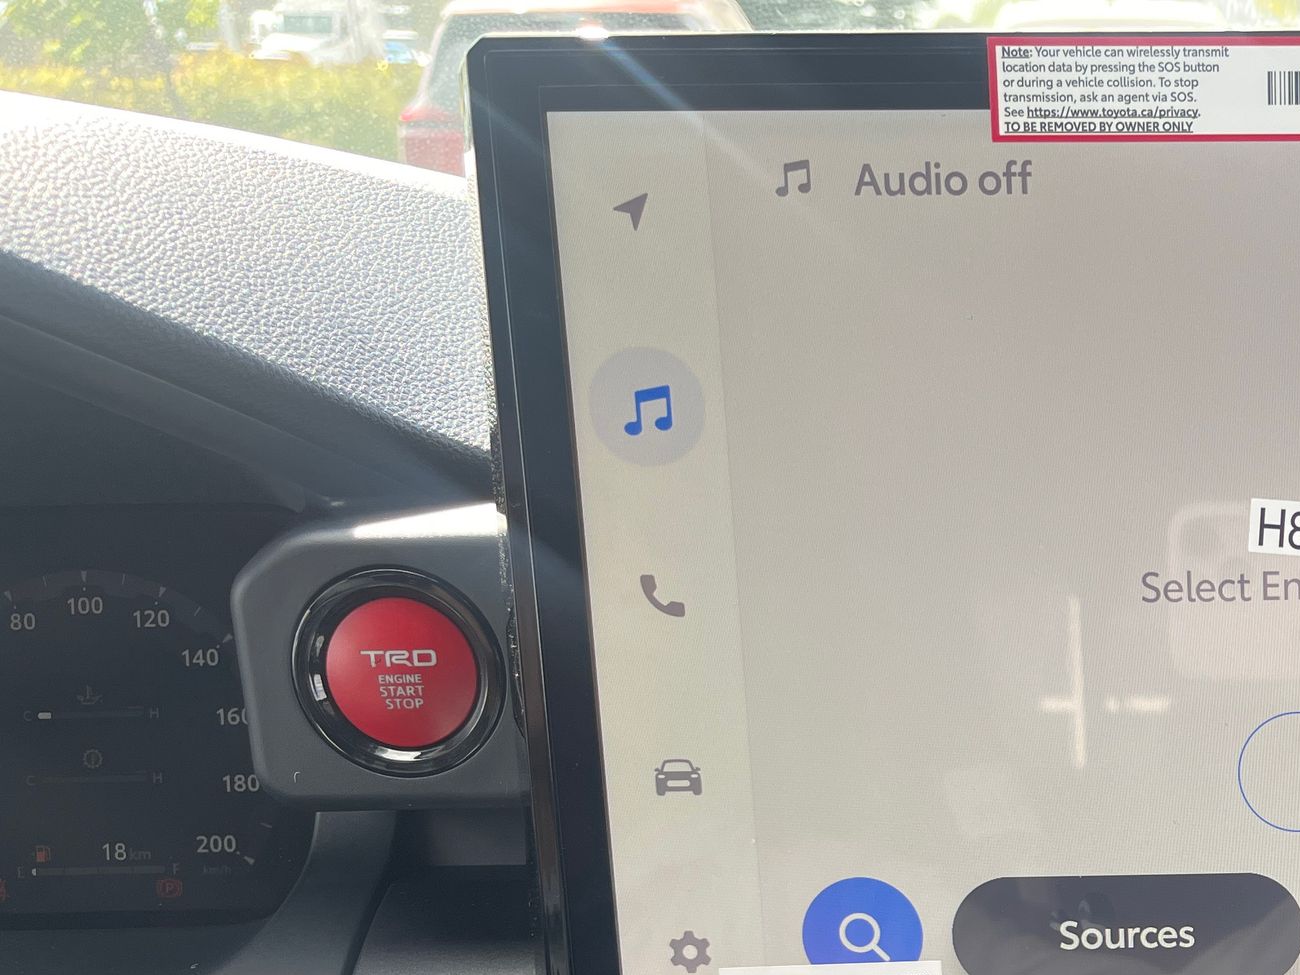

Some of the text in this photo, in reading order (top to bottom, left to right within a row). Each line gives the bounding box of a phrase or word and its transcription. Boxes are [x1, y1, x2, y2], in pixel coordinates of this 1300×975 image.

[1001, 46, 1230, 59] Note: Your vehicle can wirelessly transmit
[1002, 61, 1220, 75] location data by pressing the SOS button
[1003, 77, 1199, 90] or during a vehicle collision. To stop
[1003, 92, 1197, 105] transmission, ask an agent via SOS.
[1004, 106, 1201, 119] See https://www.toyota.ca/privacy.
[1004, 121, 1194, 133] TO BE REMOVED BY OWNER ONLY
[855, 160, 1033, 196] Audio off
[1140, 571, 1251, 603] Select
[67, 597, 103, 615] 100
[10, 612, 36, 630] 80
[133, 610, 170, 628] 120
[181, 648, 219, 666] 140
[360, 649, 437, 668] TRD
[378, 674, 422, 684] ENGINE
[380, 685, 424, 697] START
[386, 698, 424, 709] STOP
[222, 774, 260, 792] 180
[102, 843, 127, 861] 18
[196, 834, 237, 854] 200
[1059, 920, 1196, 951] Sources
